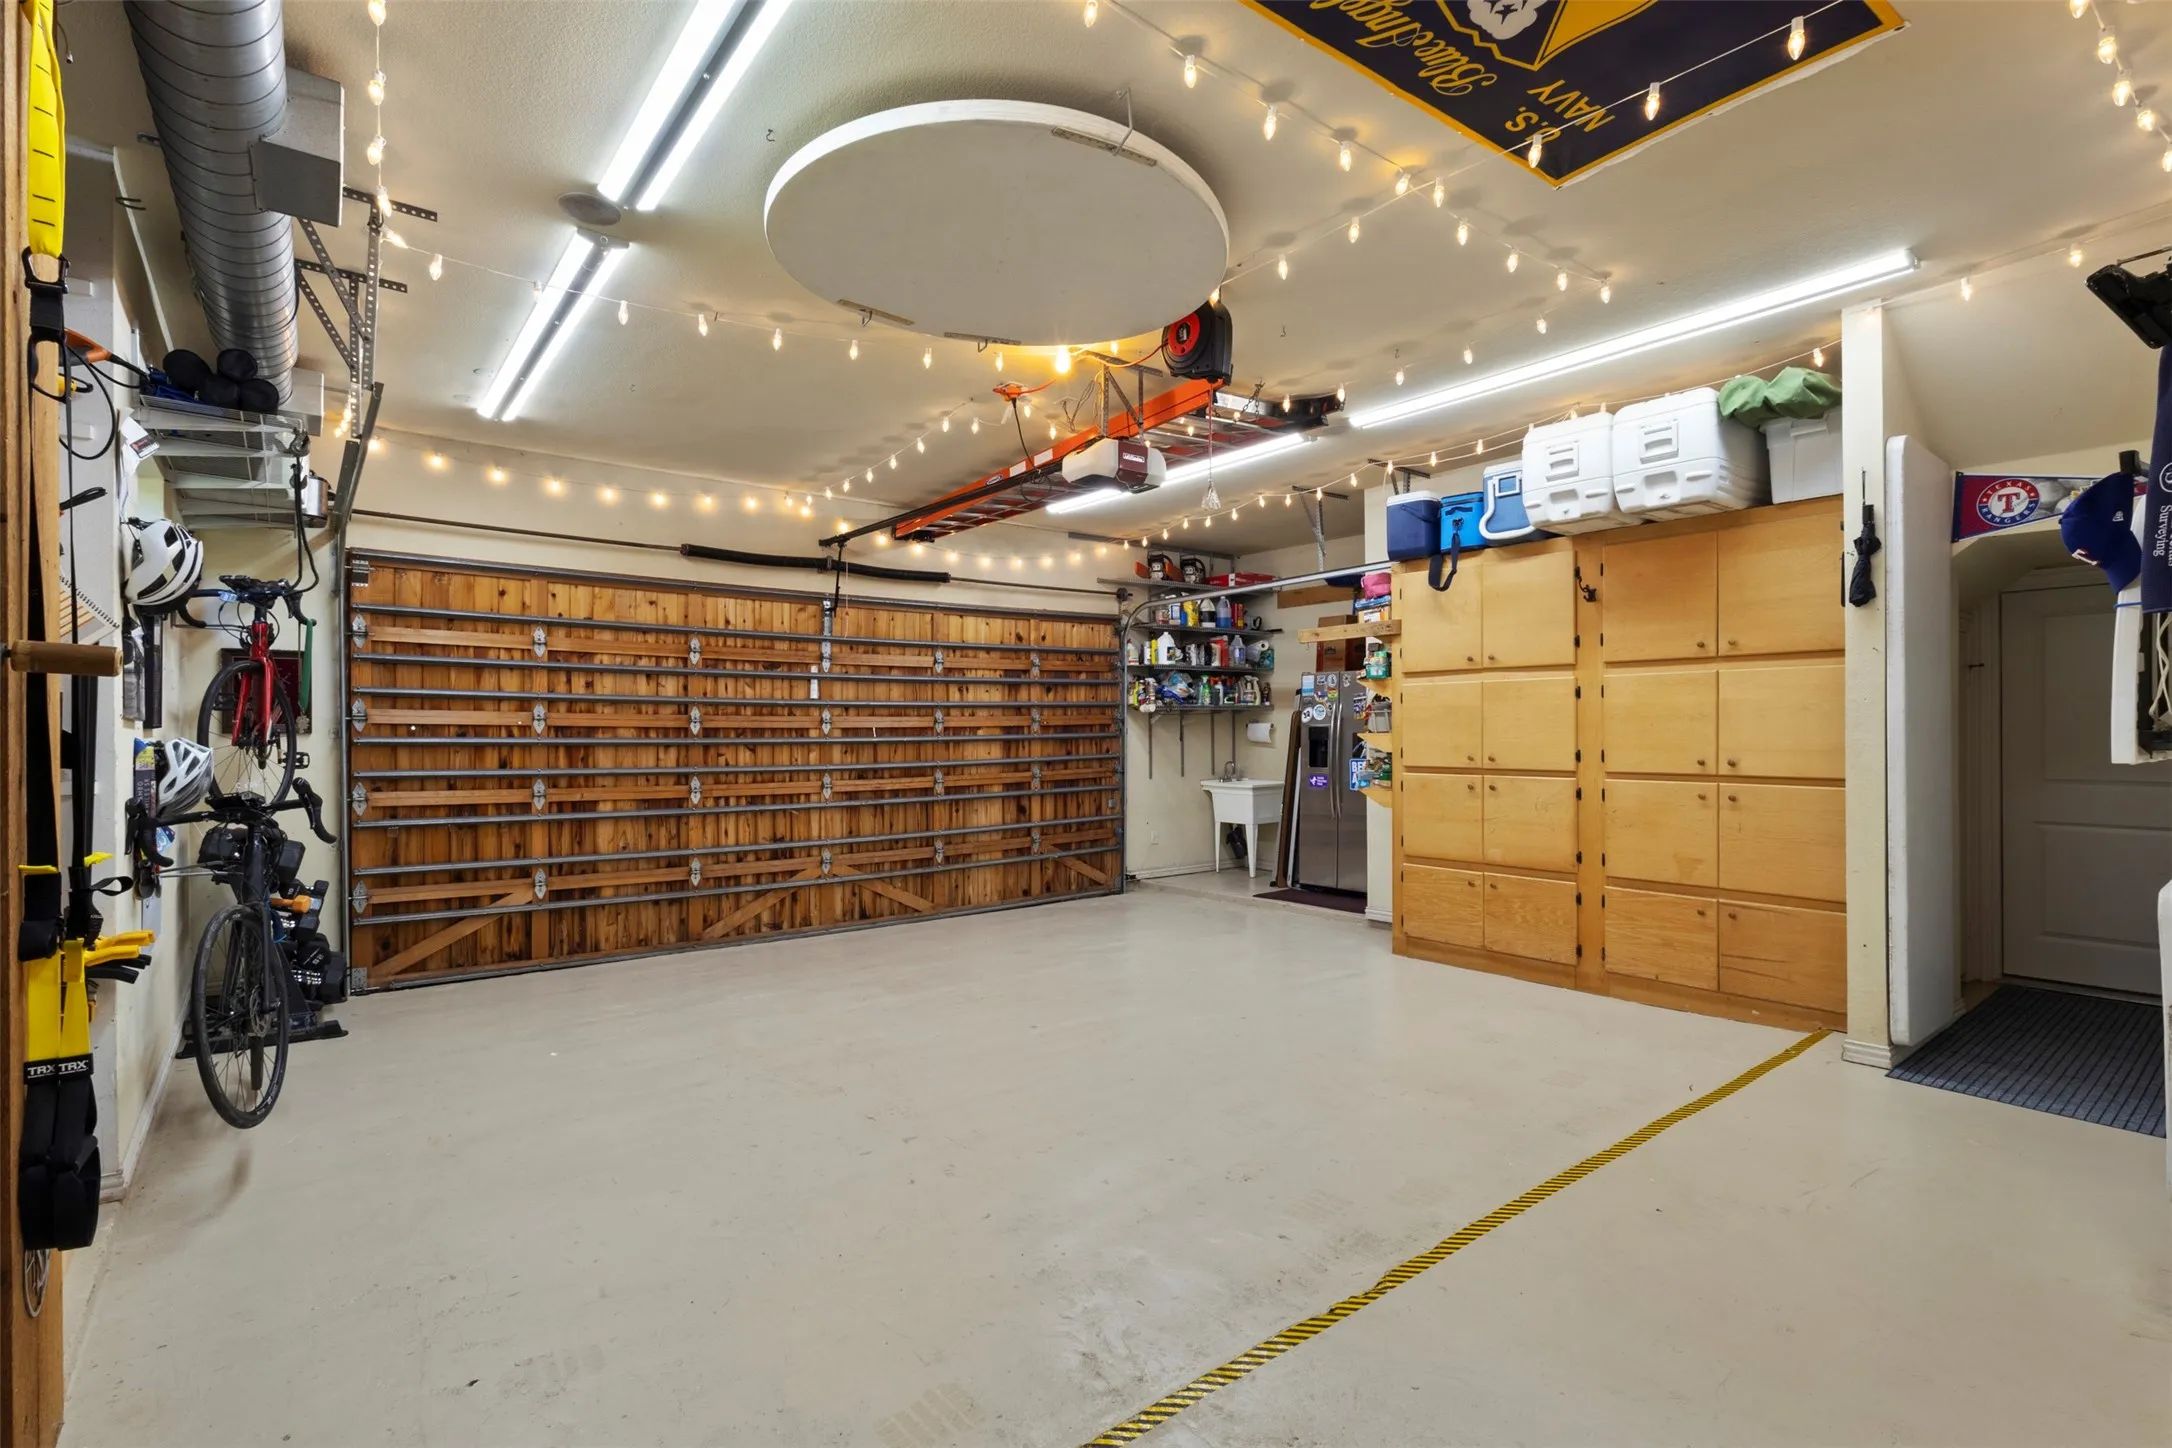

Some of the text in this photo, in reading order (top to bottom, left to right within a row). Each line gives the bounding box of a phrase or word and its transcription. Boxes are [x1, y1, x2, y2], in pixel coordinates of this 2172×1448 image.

[1413, 31, 1498, 96] Blue
[1526, 79, 1616, 133] NAVY
[1986, 481, 2032, 495] TEXAS
[1997, 492, 2021, 513] T
[1981, 503, 2036, 524] RANGERS
[2153, 504, 2172, 557] Surveying
[27, 1064, 56, 1076] TRX
[58, 1060, 89, 1072] TRX
